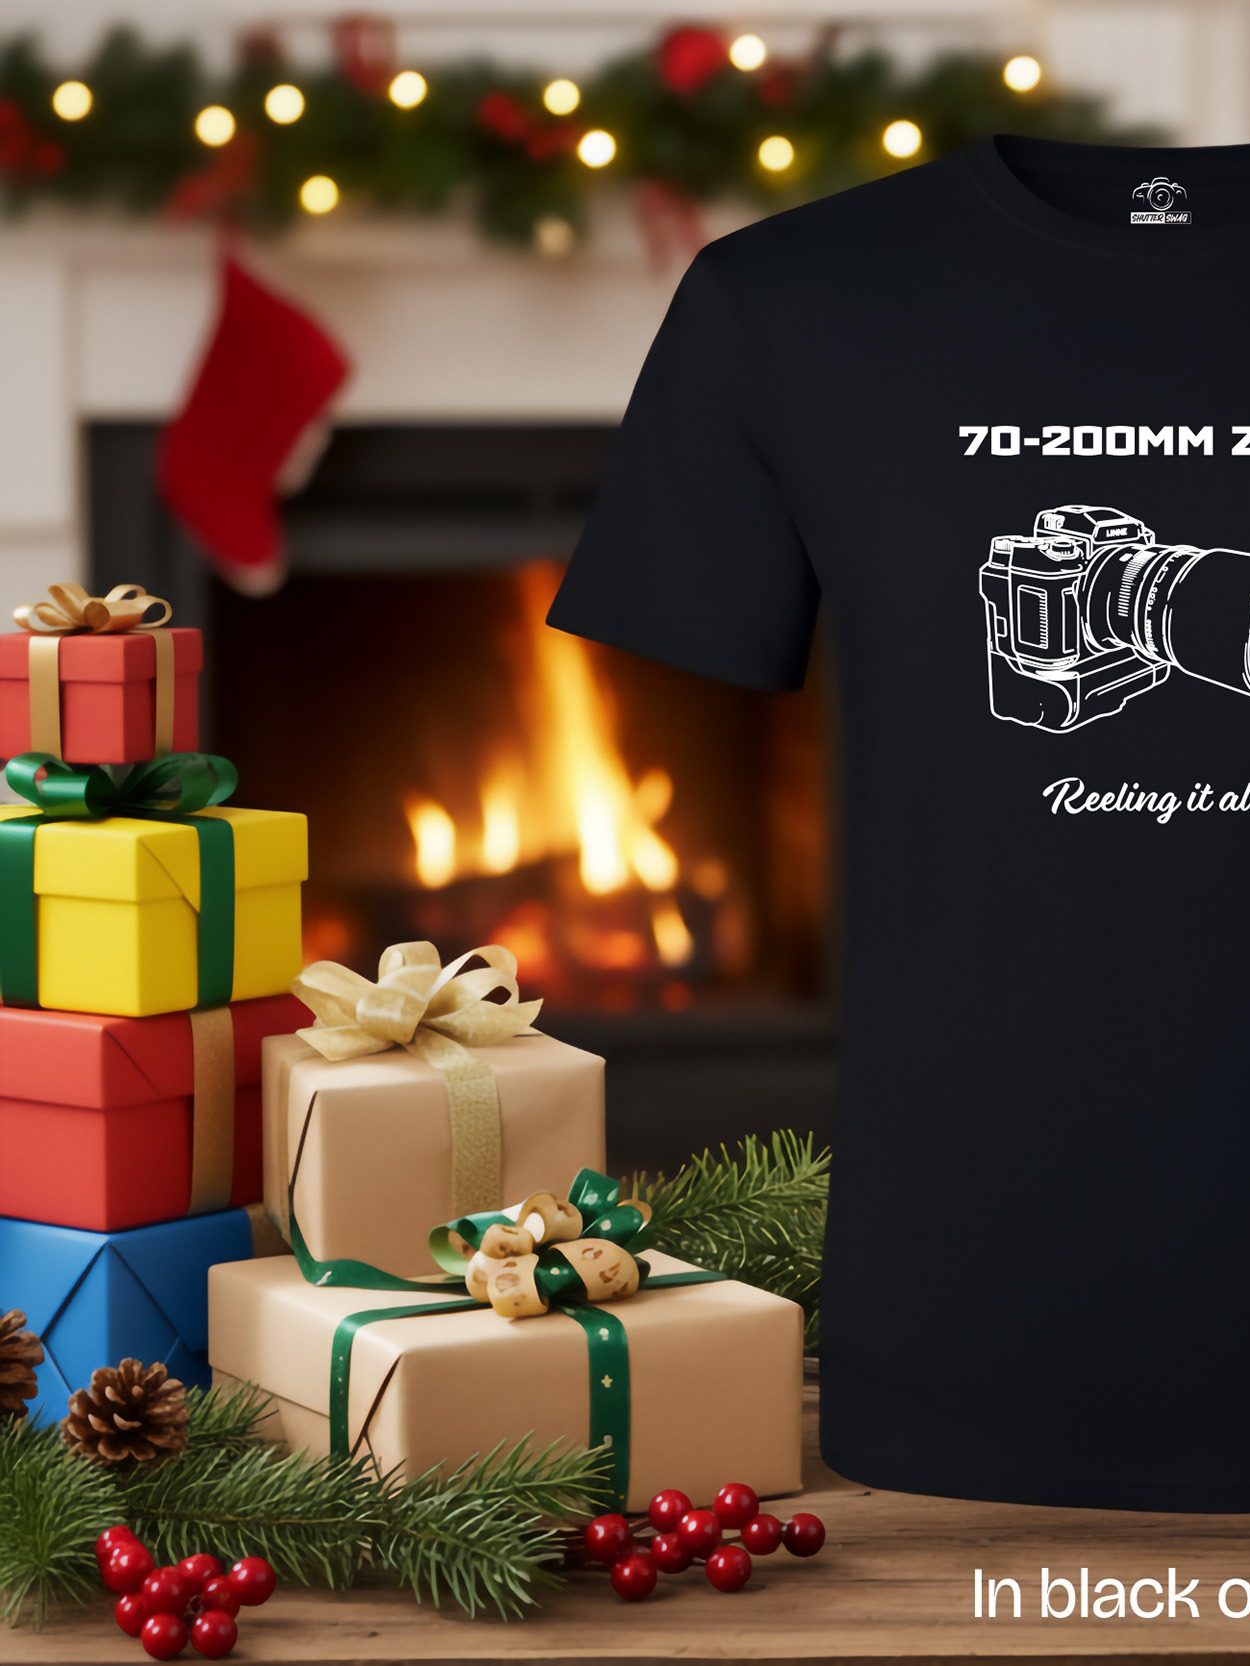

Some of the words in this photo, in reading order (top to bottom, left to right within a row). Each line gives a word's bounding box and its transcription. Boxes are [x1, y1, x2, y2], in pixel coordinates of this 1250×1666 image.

[959, 426, 1214, 456] 70-200MM
[1042, 777, 1182, 824] Reeling
[1187, 783, 1214, 812] it
